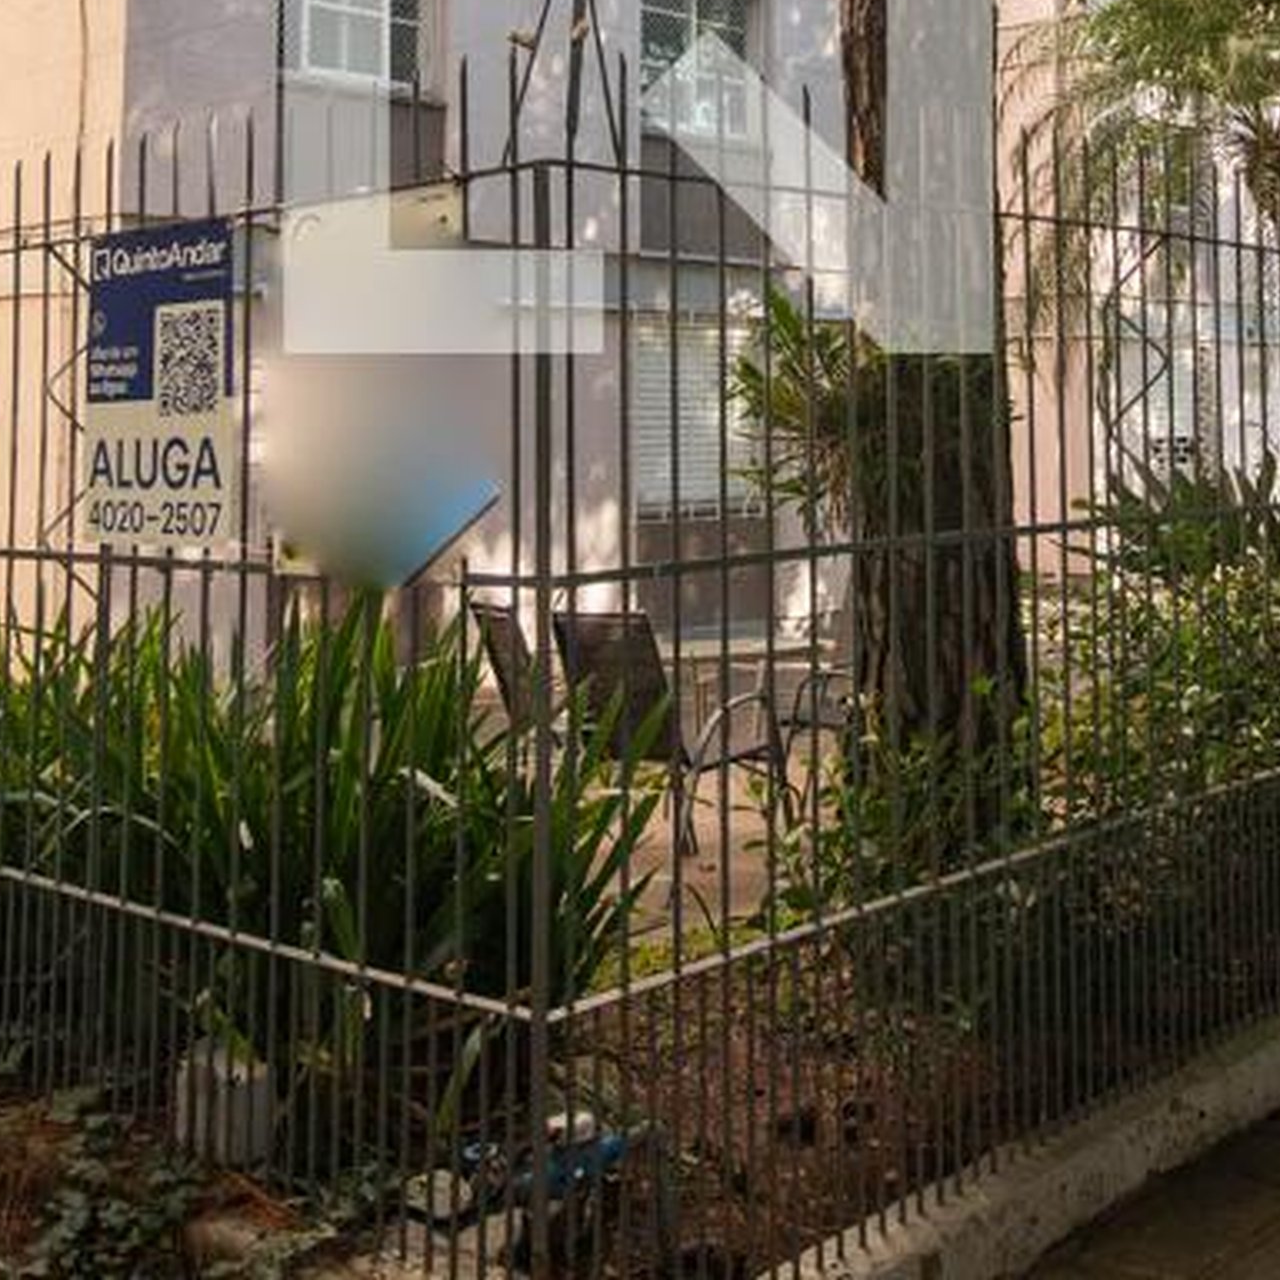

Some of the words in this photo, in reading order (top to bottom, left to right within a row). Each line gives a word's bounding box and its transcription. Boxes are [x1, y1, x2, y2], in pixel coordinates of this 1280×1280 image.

[112, 239, 227, 275] QuintoAndar
[89, 437, 222, 490] ALUGA
[87, 500, 222, 537] 4020-2507
